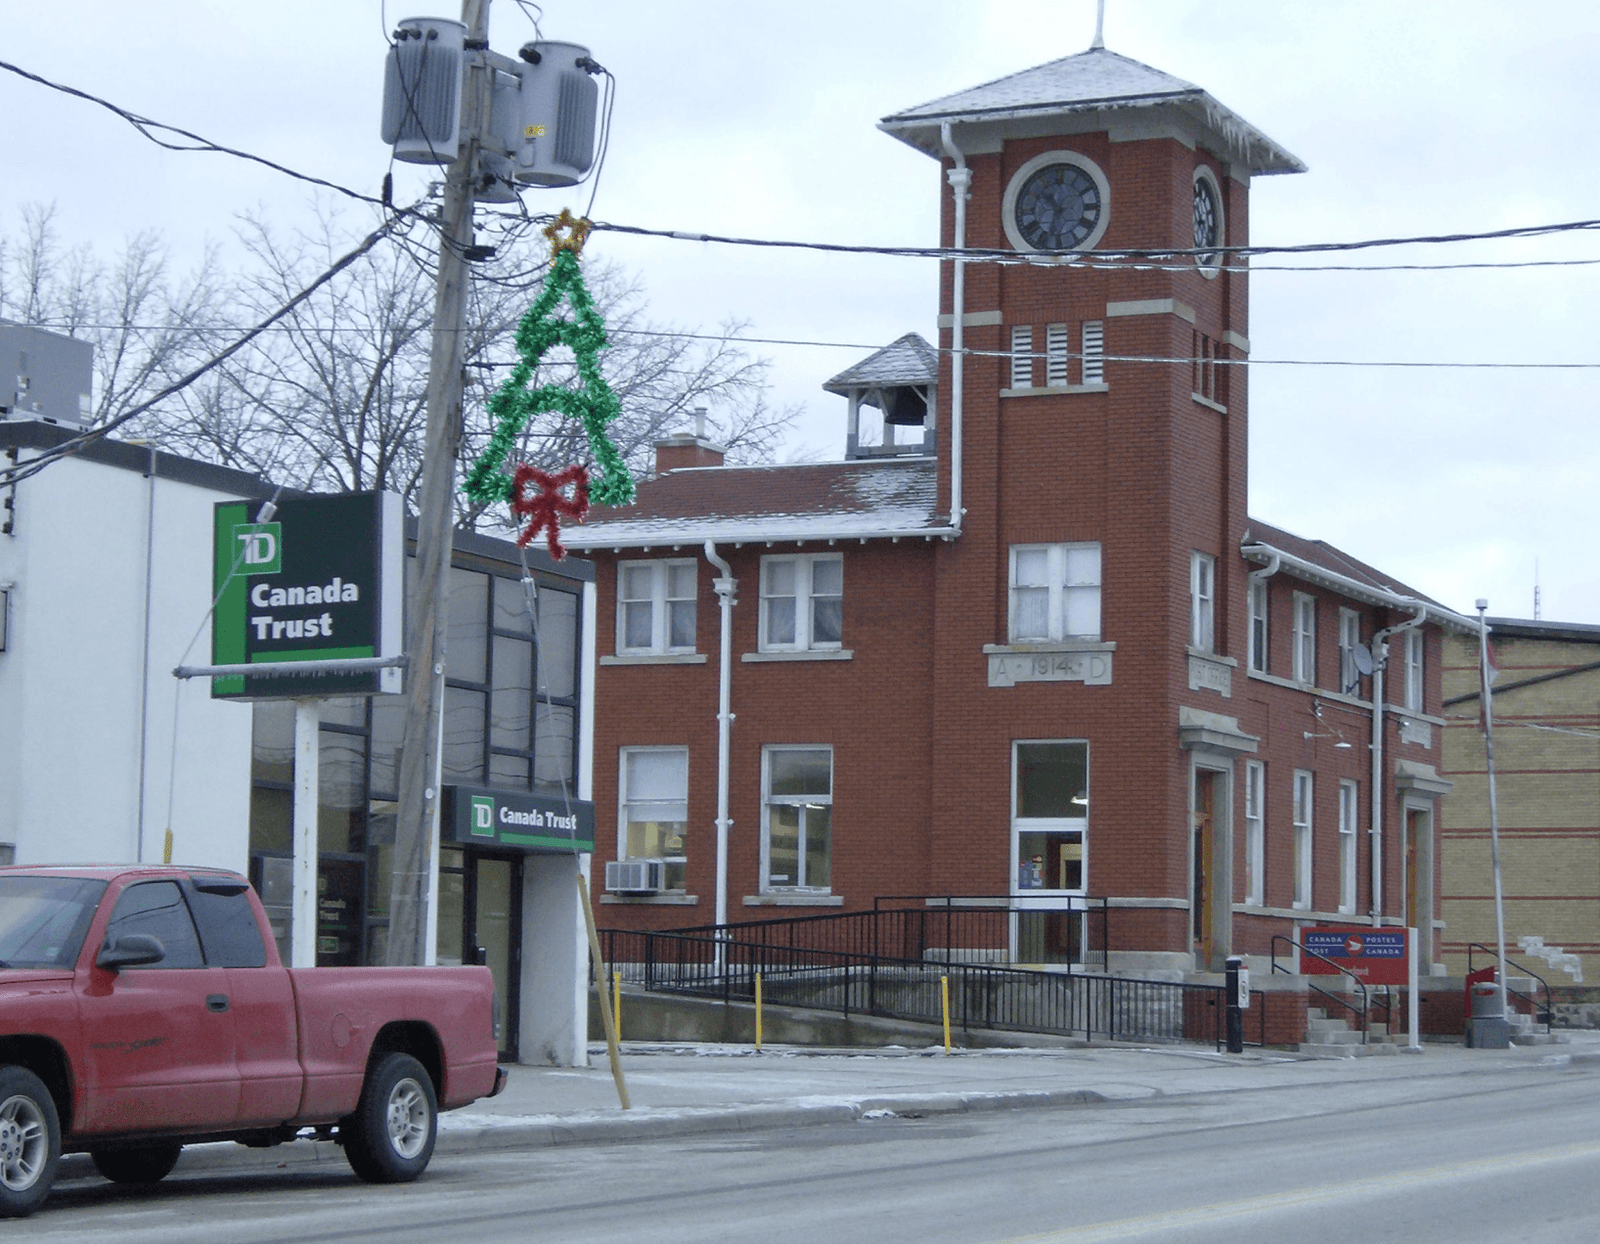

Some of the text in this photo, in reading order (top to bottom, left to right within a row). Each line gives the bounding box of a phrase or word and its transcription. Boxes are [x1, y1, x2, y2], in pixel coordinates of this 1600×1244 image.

[237, 533, 276, 563] TD
[251, 577, 358, 607] Canada
[251, 612, 333, 640] Trust
[994, 656, 1107, 681] A 1914 D
[474, 804, 577, 830] TD Canada Trust
